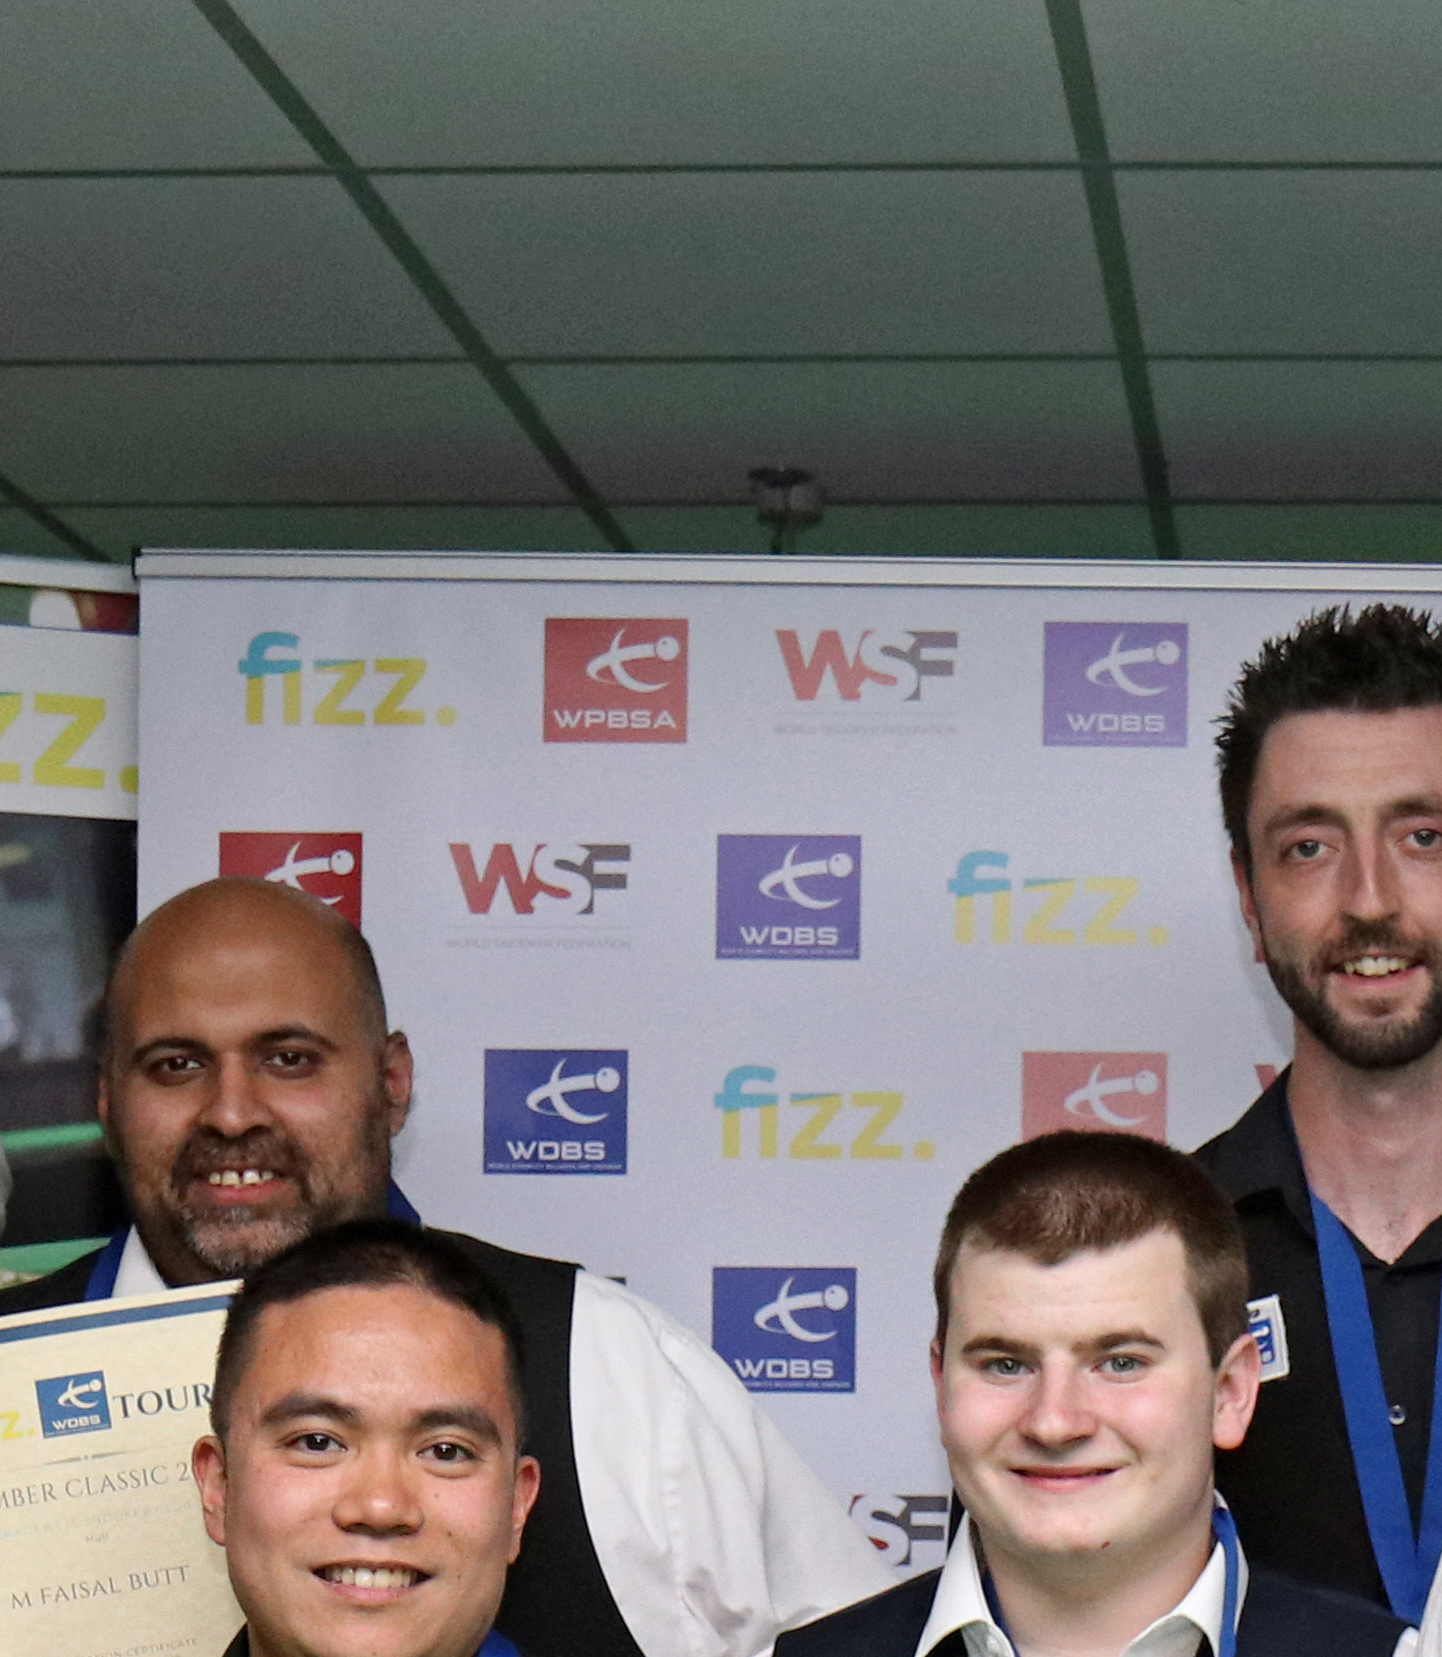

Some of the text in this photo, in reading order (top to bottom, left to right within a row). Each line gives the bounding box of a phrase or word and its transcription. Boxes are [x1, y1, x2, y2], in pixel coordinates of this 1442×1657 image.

[238, 631, 456, 726] fizz.
[774, 629, 957, 701] WSF
[554, 709, 677, 729] WPBSA
[1065, 713, 1165, 732] WDBS
[449, 842, 631, 914] WSF
[948, 851, 1169, 946] fizz.
[740, 926, 838, 946] WDBS
[713, 1065, 935, 1160] fizz.
[507, 1140, 606, 1161] WDBS
[734, 1358, 835, 1379] WDBS
[52, 1414, 101, 1431] WDBS
[113, 1383, 213, 1419] TOUR
[65, 1465, 168, 1499] CLASSIC
[11, 1564, 190, 1609] M FAISAL BUTT
